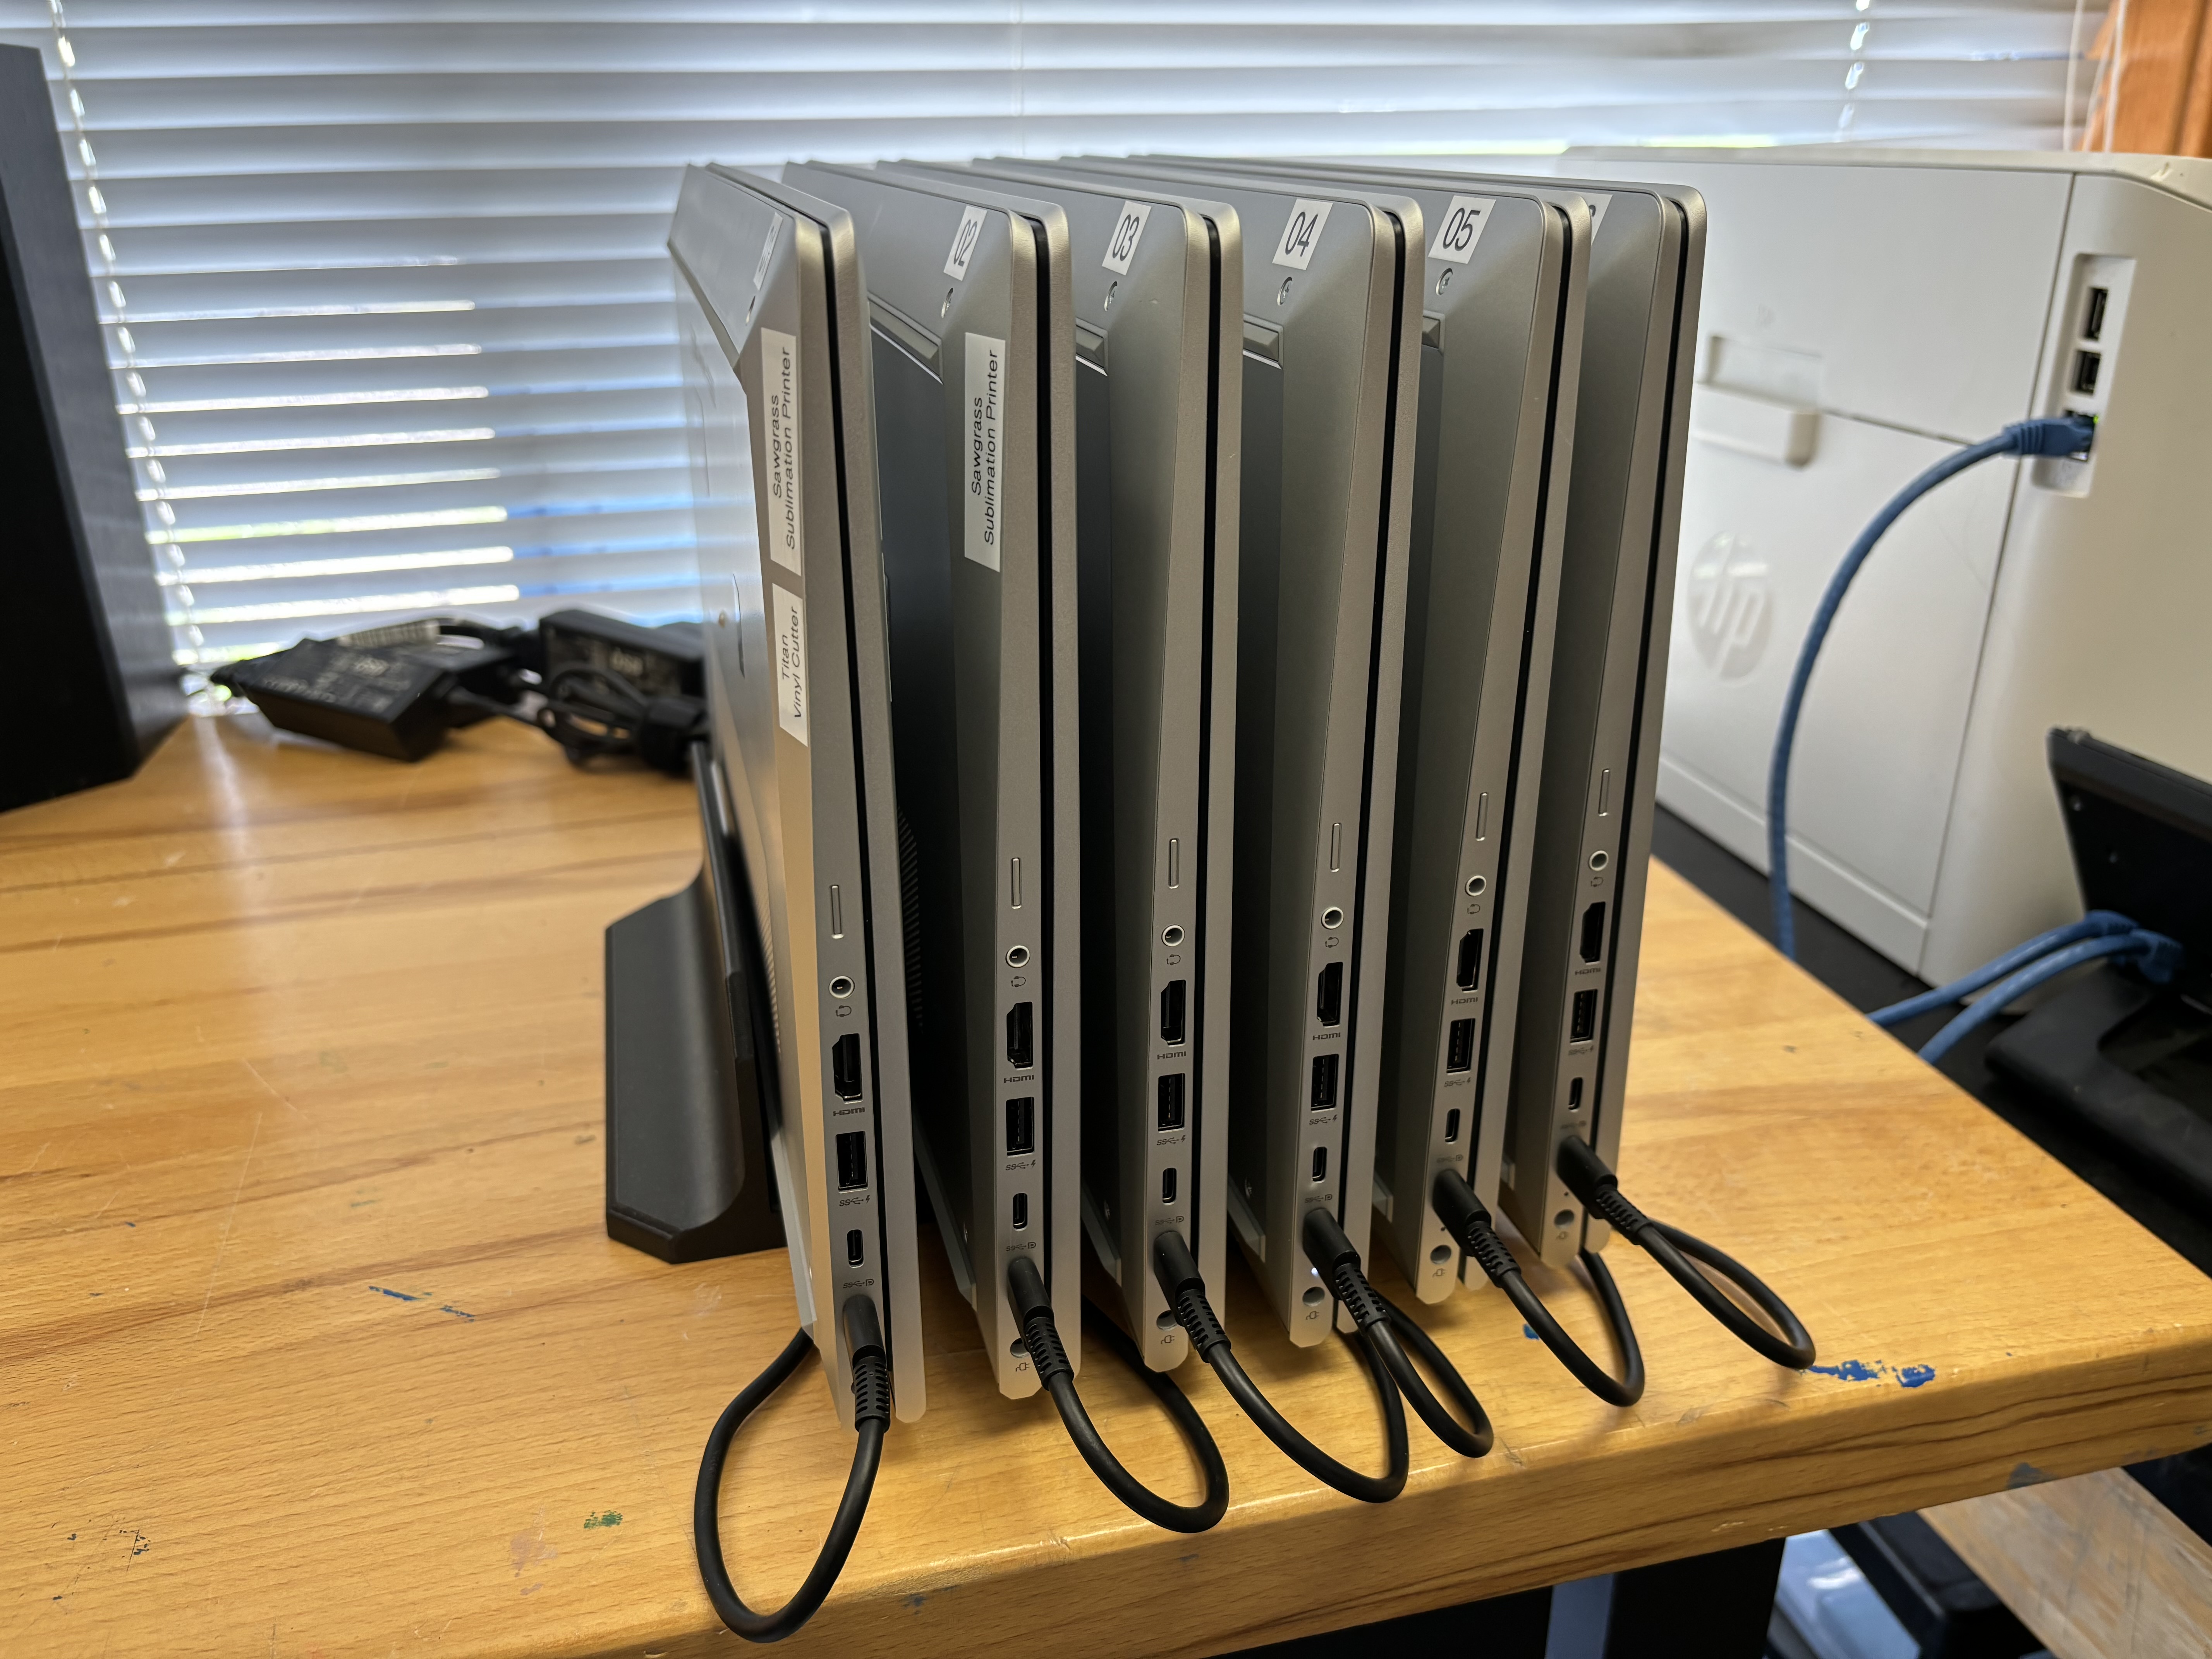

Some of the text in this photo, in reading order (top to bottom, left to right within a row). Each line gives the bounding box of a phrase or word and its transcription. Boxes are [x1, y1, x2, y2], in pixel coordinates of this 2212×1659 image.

[954, 219, 977, 267] 02
[1112, 214, 1140, 261] 03
[1285, 211, 1318, 257] 04
[1443, 208, 1481, 251] 05
[772, 395, 781, 498] Sawgrass
[782, 347, 795, 550] Sublimation Printer
[971, 397, 983, 496] Sawgrass
[984, 349, 998, 545] Sublimation Printer
[1694, 531, 1770, 680] hp
[791, 606, 802, 718] Vinyl Cutter
[1451, 997, 1478, 1005] HDMI
[1157, 1051, 1187, 1060] HDMI
[1312, 1032, 1341, 1041] HDMI
[1003, 1075, 1034, 1084] HDMI
[833, 1107, 865, 1116] HDMI
